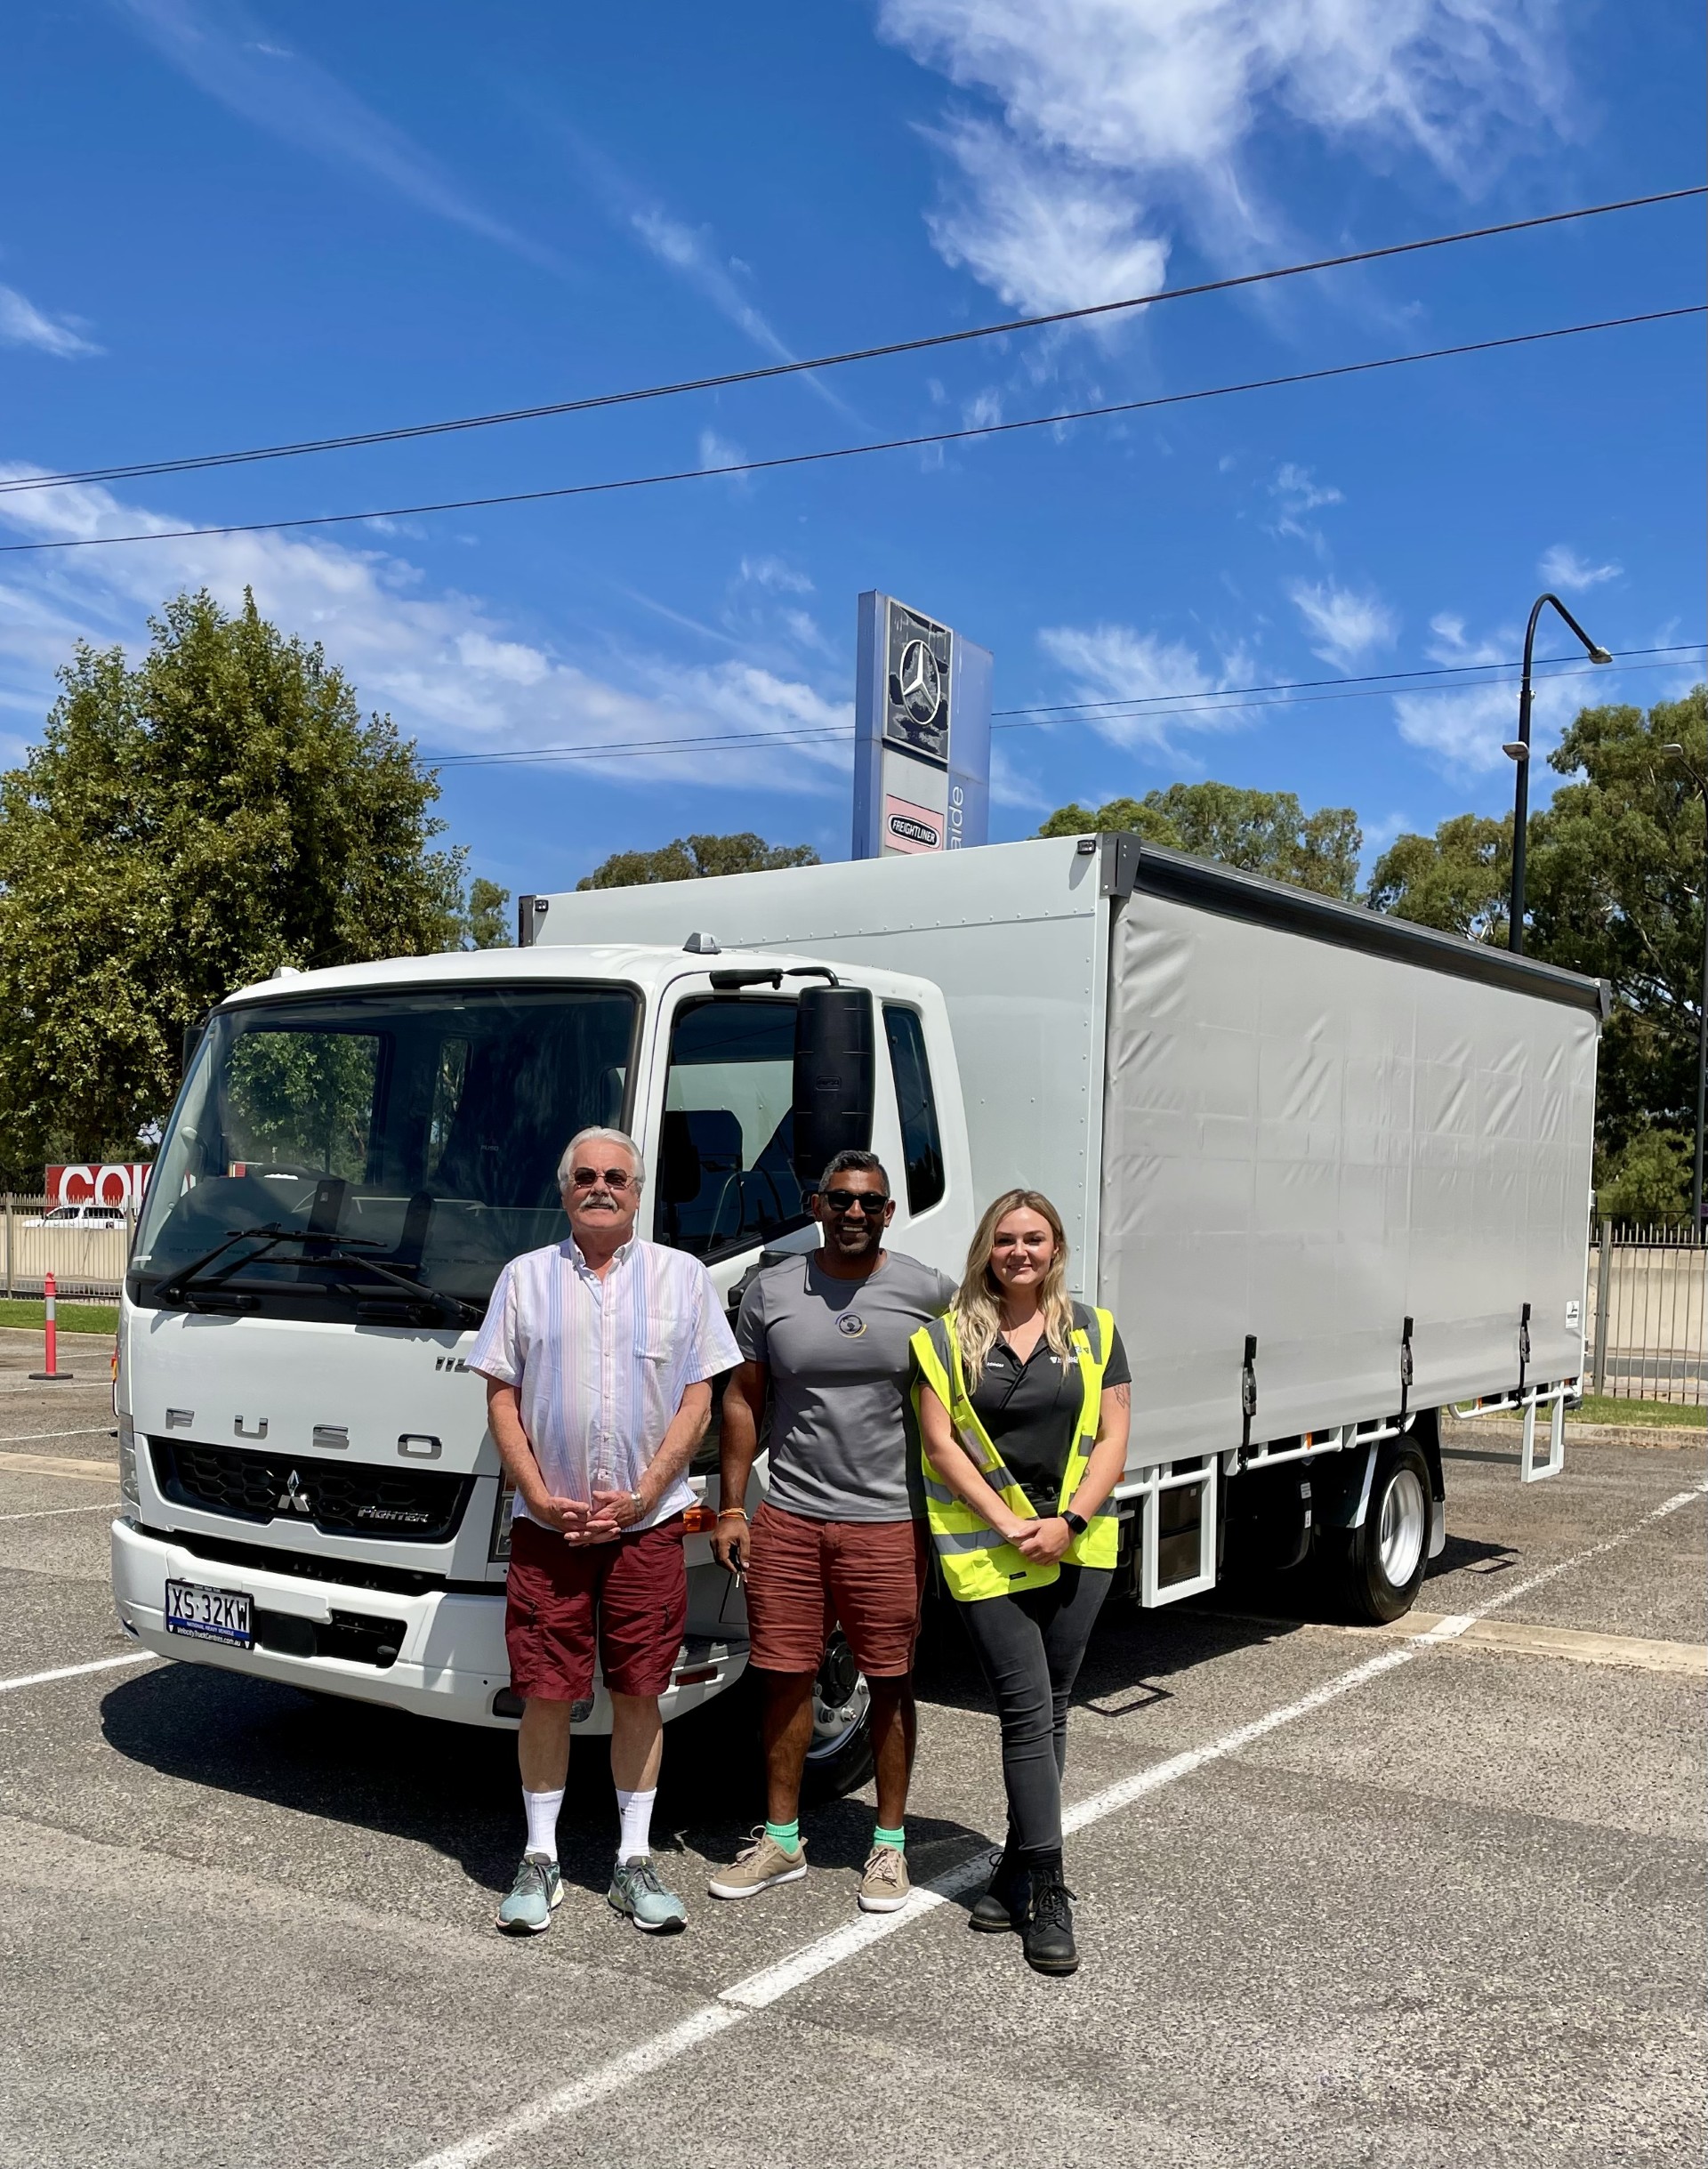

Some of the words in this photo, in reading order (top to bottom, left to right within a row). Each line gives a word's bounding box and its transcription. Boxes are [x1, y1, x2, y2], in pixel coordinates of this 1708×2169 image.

[892, 819, 936, 843] FREIGHTLINER
[165, 1407, 443, 1460] FUSO
[186, 1620, 205, 1631] NATIONAL
[205, 1625, 218, 1633] HEAVY
[218, 1627, 235, 1637] VEHICLE
